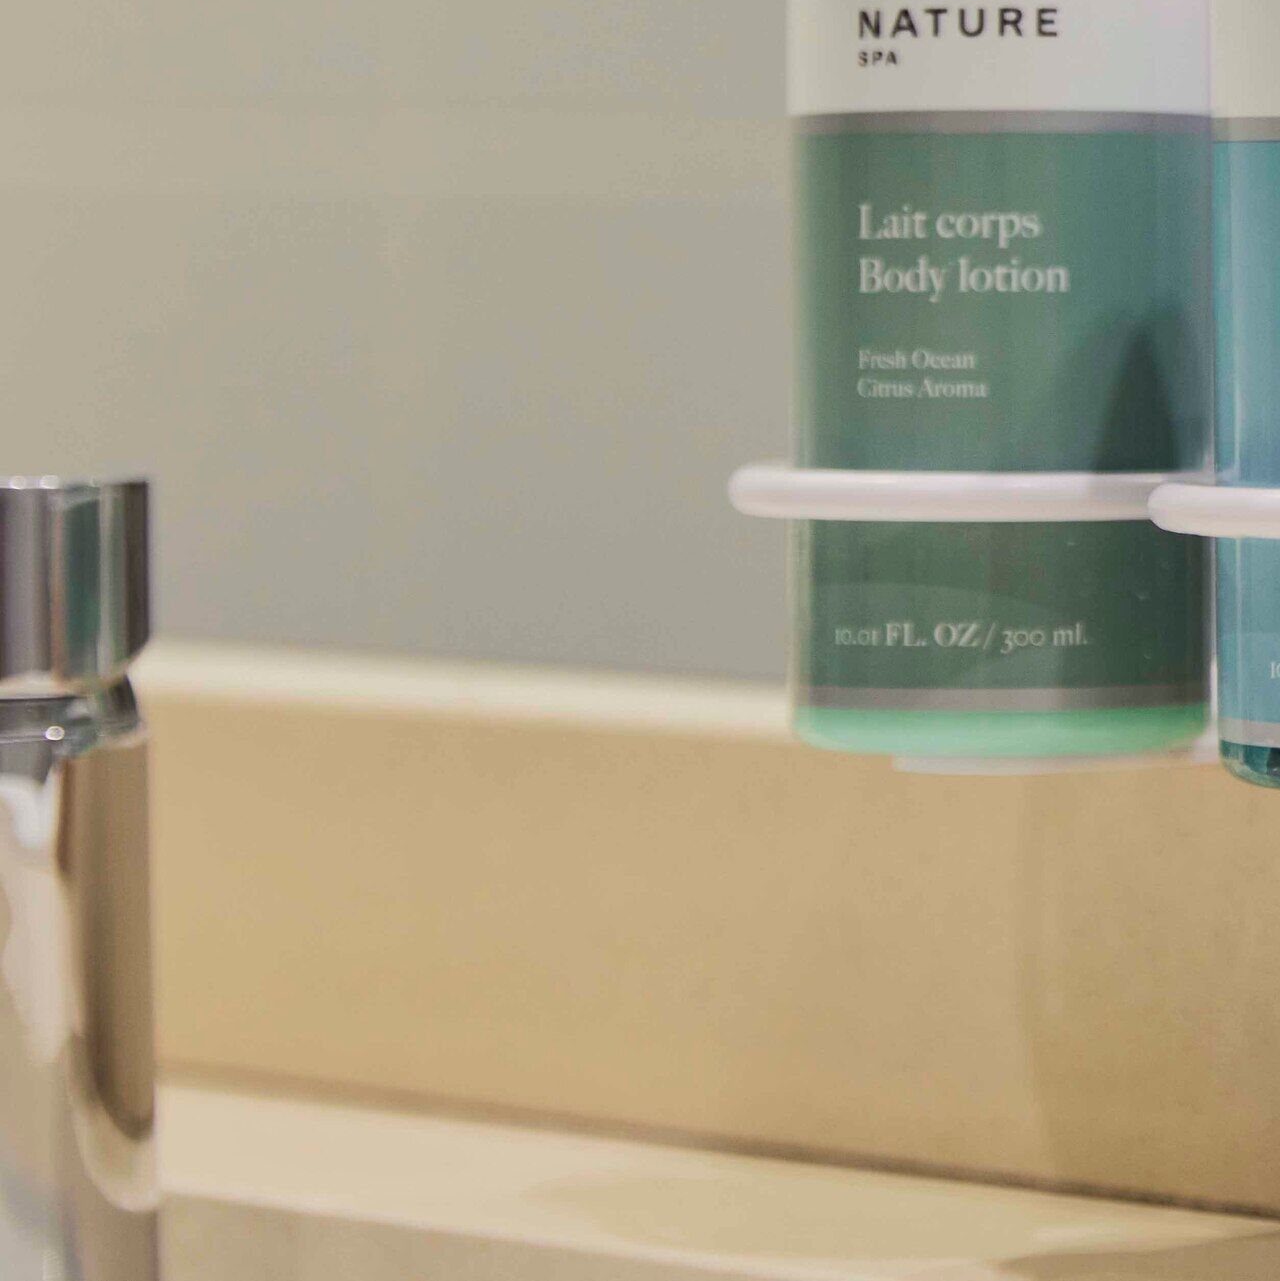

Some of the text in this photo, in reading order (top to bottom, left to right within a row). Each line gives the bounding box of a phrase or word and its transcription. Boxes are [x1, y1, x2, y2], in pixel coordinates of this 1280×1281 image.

[858, 7, 1058, 39] NATURE
[858, 50, 898, 67] SPA
[858, 203, 1043, 249] Lait corps
[858, 255, 1071, 303] Body lotion
[858, 349, 976, 370] Fresh Ocean
[856, 377, 990, 398] Citrus Aroma
